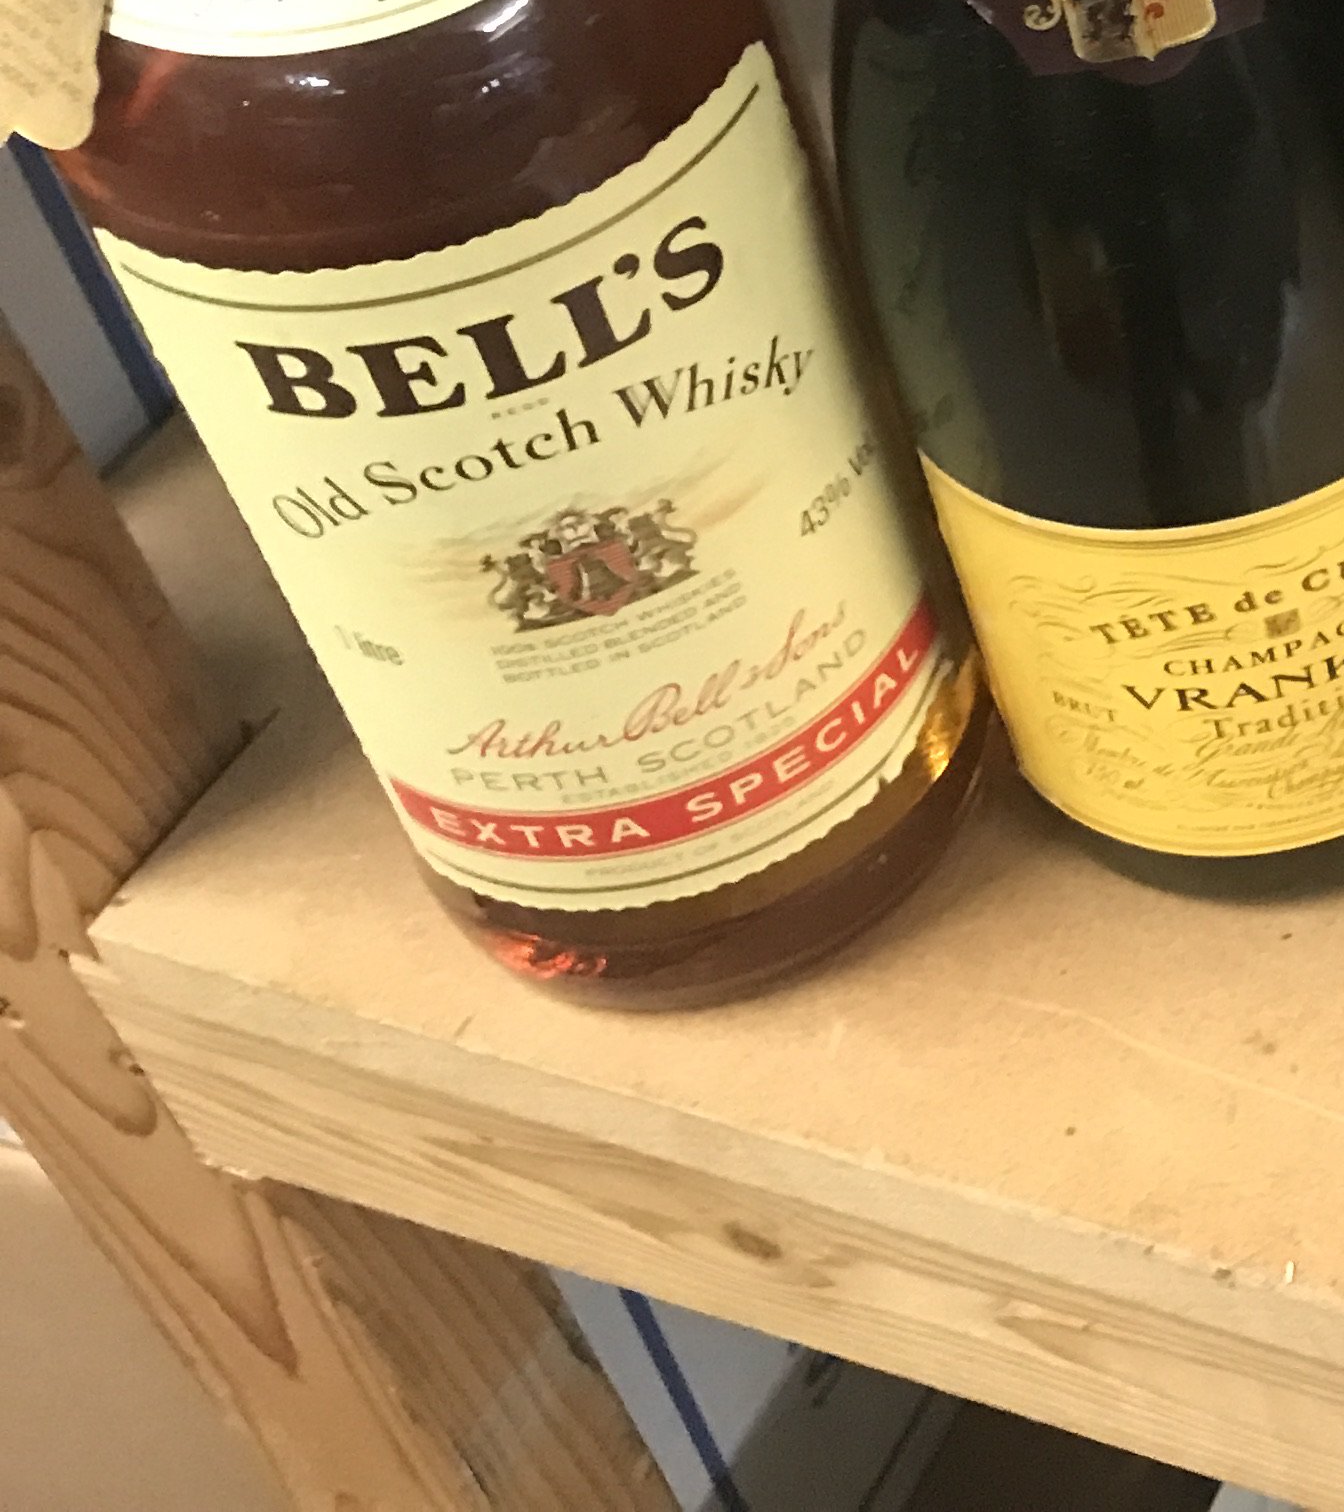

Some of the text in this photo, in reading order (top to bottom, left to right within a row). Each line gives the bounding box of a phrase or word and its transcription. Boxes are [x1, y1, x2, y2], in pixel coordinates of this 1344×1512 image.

[234, 213, 724, 419] BELL'S
[272, 334, 815, 541] Old Scotch Whisky
[1233, 586, 1285, 615] de
[430, 641, 921, 850] EXTRA SPECIAL
[446, 718, 622, 760] Arthur
[622, 658, 744, 742] Bell
[449, 626, 868, 793] PERTH SCOTLAND
